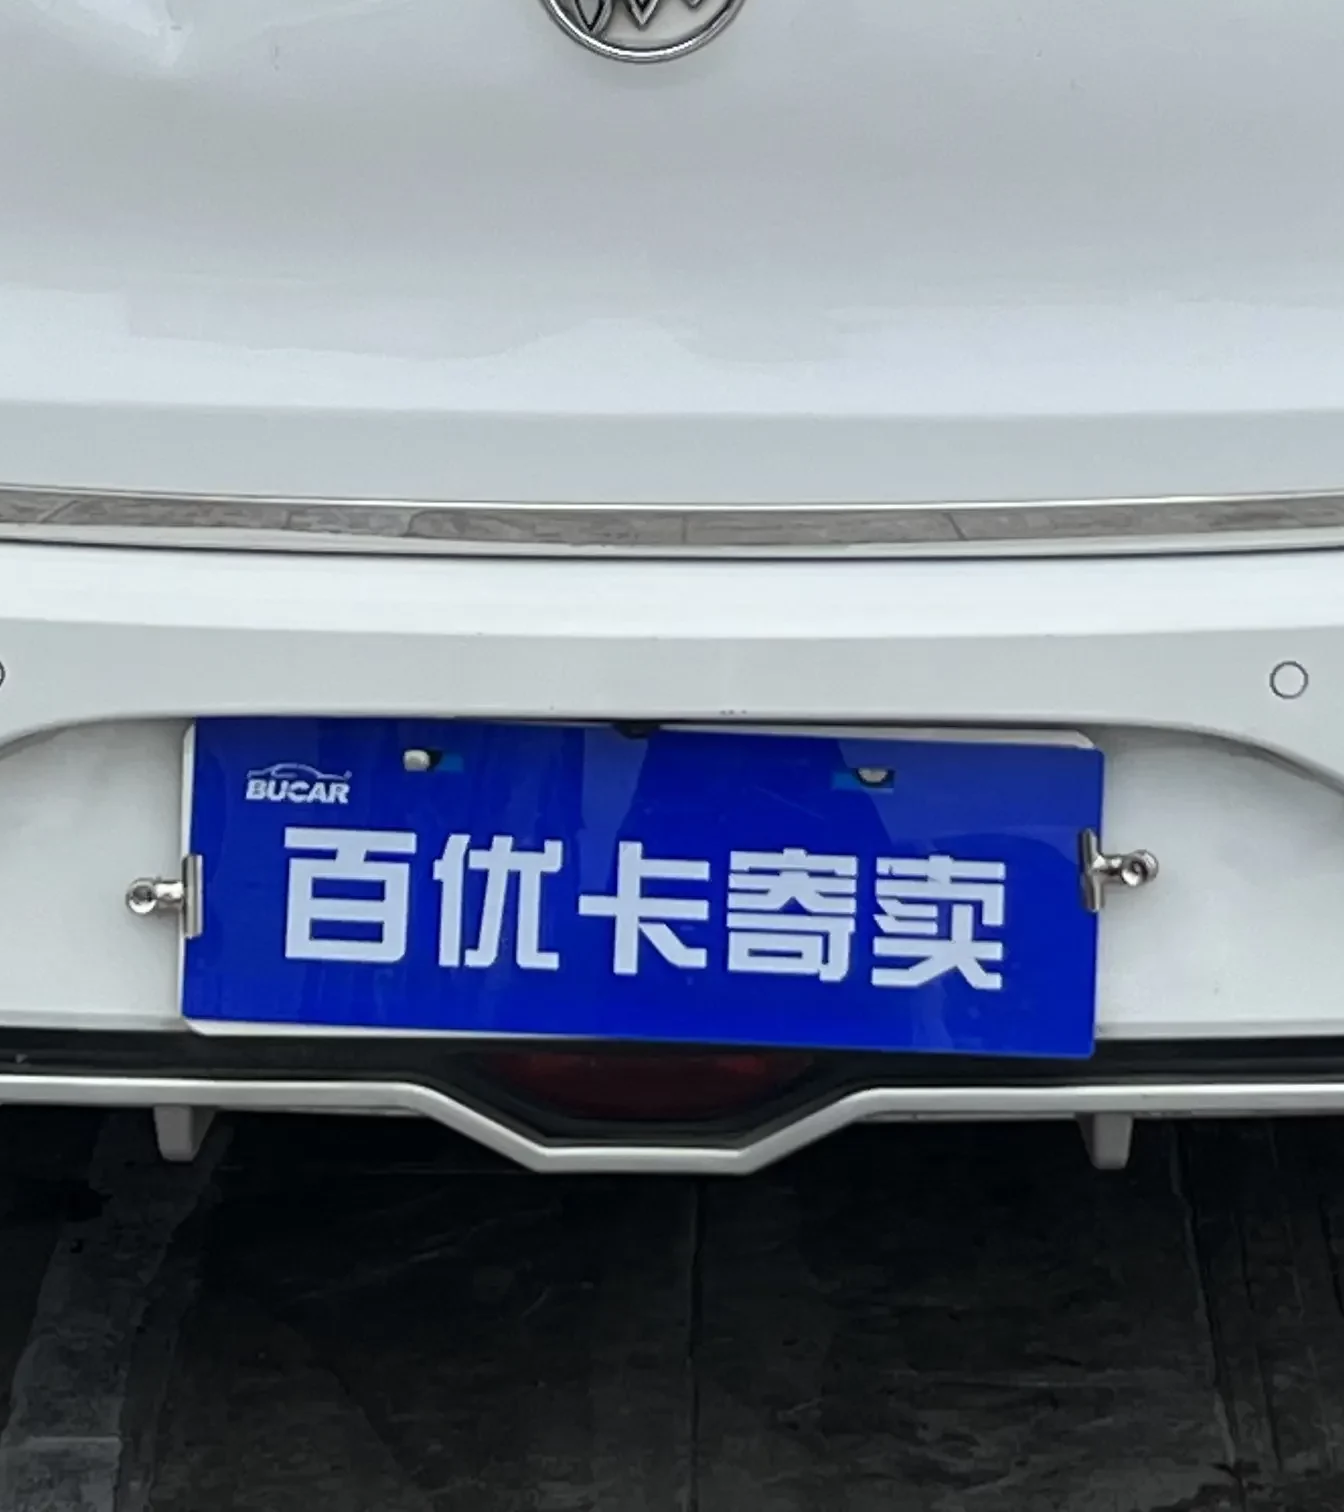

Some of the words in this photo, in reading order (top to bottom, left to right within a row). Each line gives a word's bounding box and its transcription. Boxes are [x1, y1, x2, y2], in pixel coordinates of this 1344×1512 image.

[245, 778, 350, 805] BUCAR
[283, 825, 1007, 991] 百优卡寄卖
